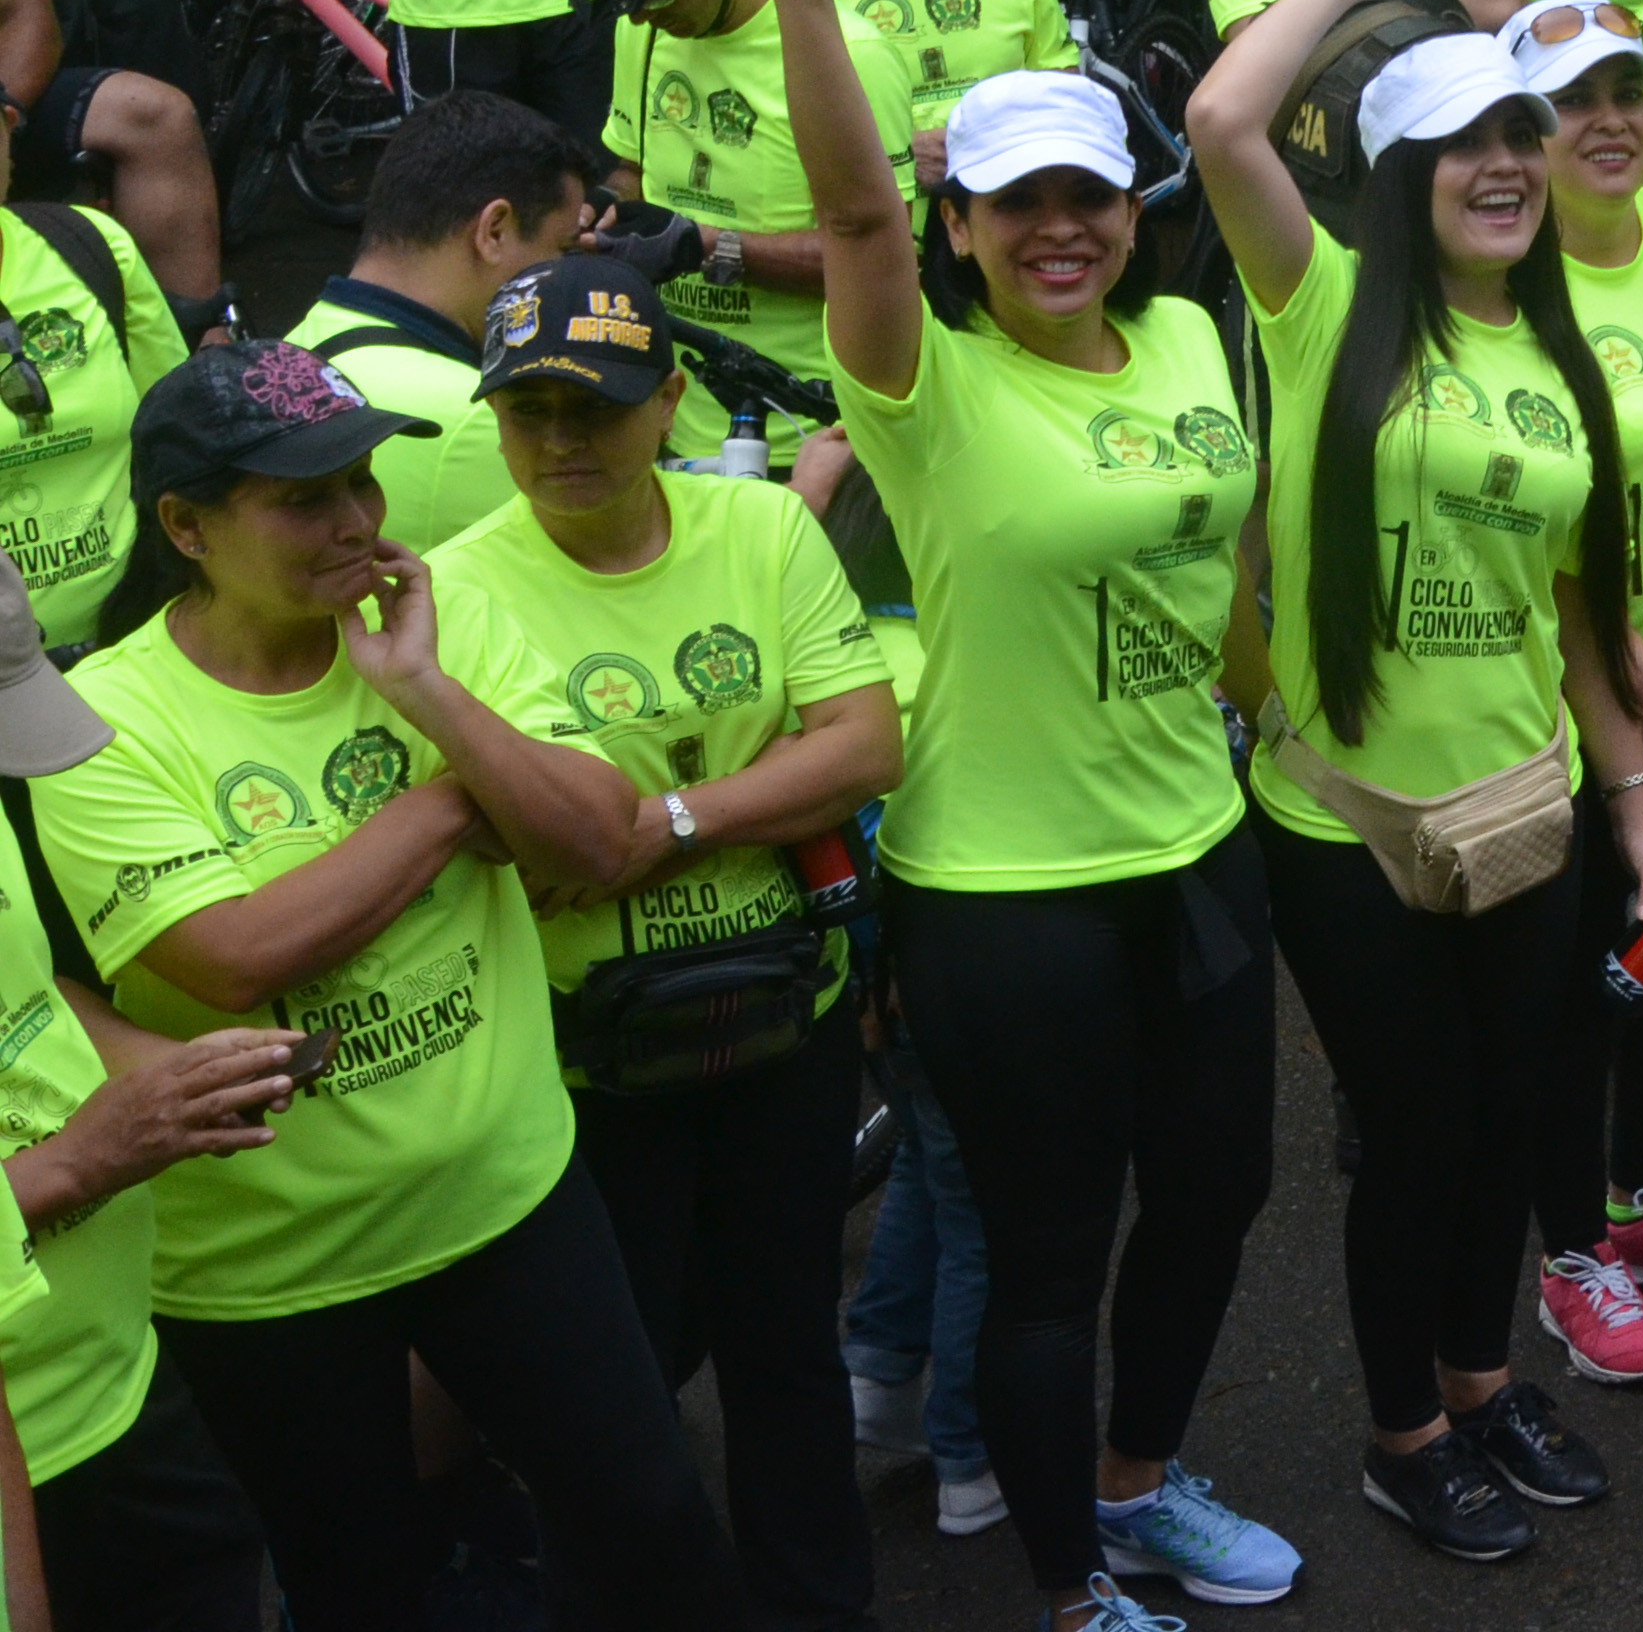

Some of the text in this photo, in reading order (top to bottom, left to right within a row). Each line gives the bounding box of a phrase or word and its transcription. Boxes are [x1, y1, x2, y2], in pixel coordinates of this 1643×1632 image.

[1287, 102, 1328, 158] CIA
[588, 291, 640, 322] U.S.
[1433, 488, 1484, 512] Alcaldía
[1498, 502, 1547, 527] Medellín
[1436, 501, 1538, 537] Cuenta con vos
[1420, 549, 1437, 567] ER
[1380, 520, 1410, 653] 1
[1409, 578, 1474, 609] CICLO
[1077, 576, 1110, 702] 1
[1115, 620, 1174, 653] CICLO
[1406, 608, 1527, 642] CONVIVENCIA
[1415, 640, 1479, 658] SEGURIDAD
[640, 883, 717, 919] CICLO
[301, 950, 470, 1041] CICLO PASEO
[320, 991, 475, 1081] CONVIVENCI
[321, 1050, 423, 1099] Y SEGURIDAD
